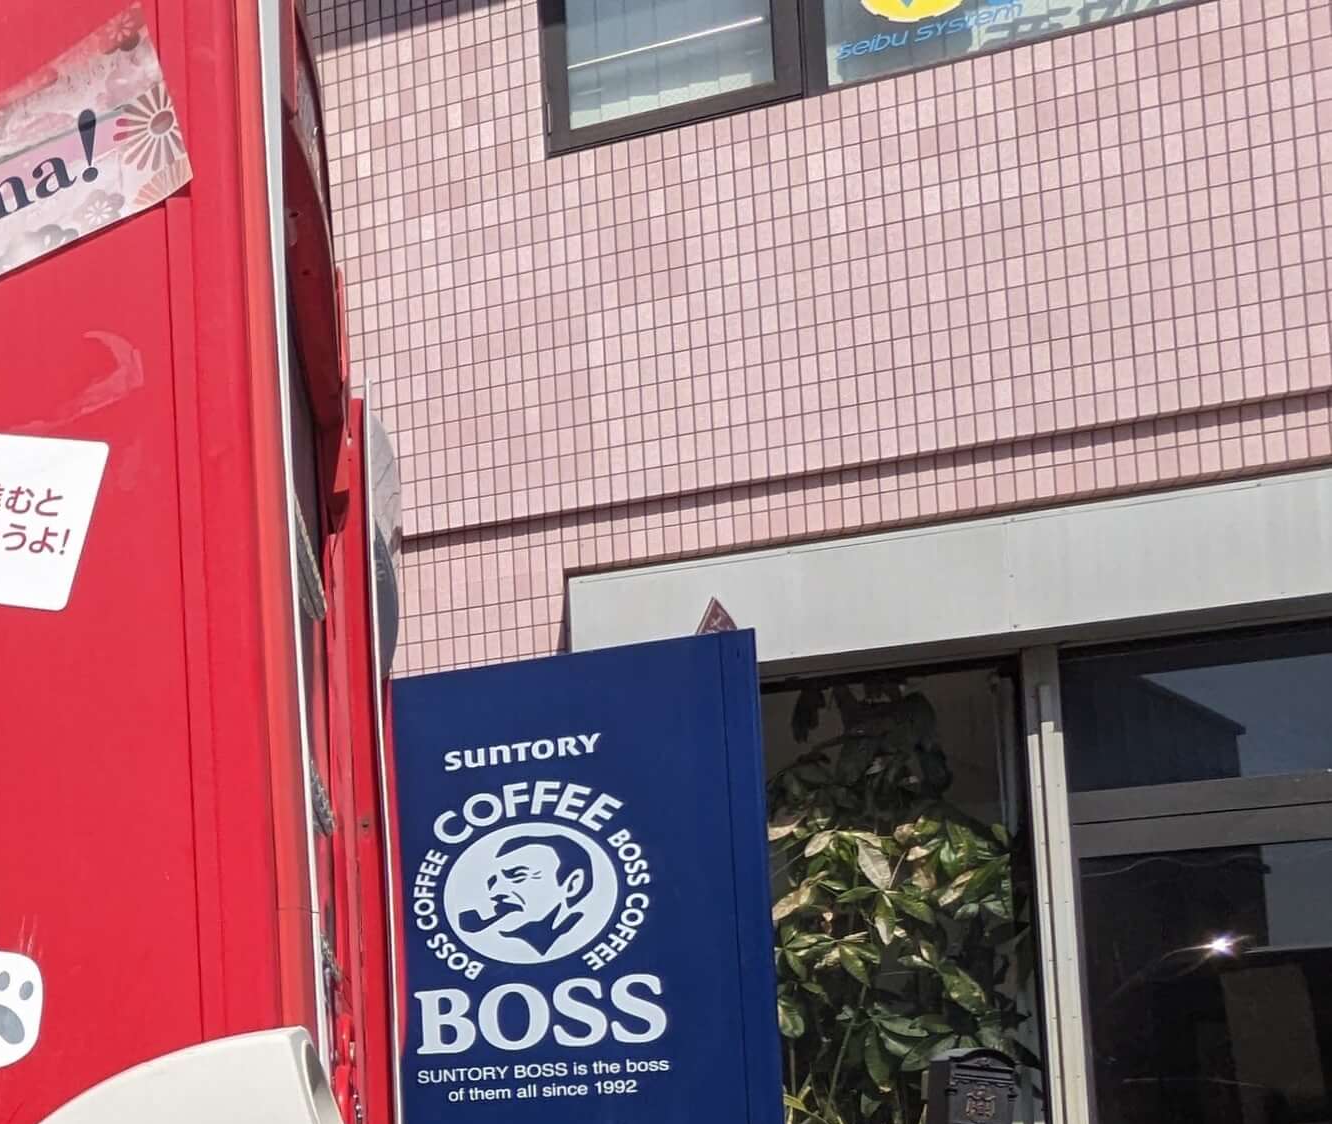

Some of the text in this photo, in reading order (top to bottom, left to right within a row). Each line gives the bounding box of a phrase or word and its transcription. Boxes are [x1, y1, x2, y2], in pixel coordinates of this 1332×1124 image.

[444, 732, 602, 771] SUNTORY
[433, 780, 624, 844] COFFEE
[413, 848, 486, 981] BOSS COFFEE
[582, 828, 651, 971] BOSS COFFEE
[414, 973, 668, 1055] BOSS
[417, 1059, 670, 1084] SUNTORY BOSS is the boss
[448, 1080, 638, 1102] of them all since 1992
